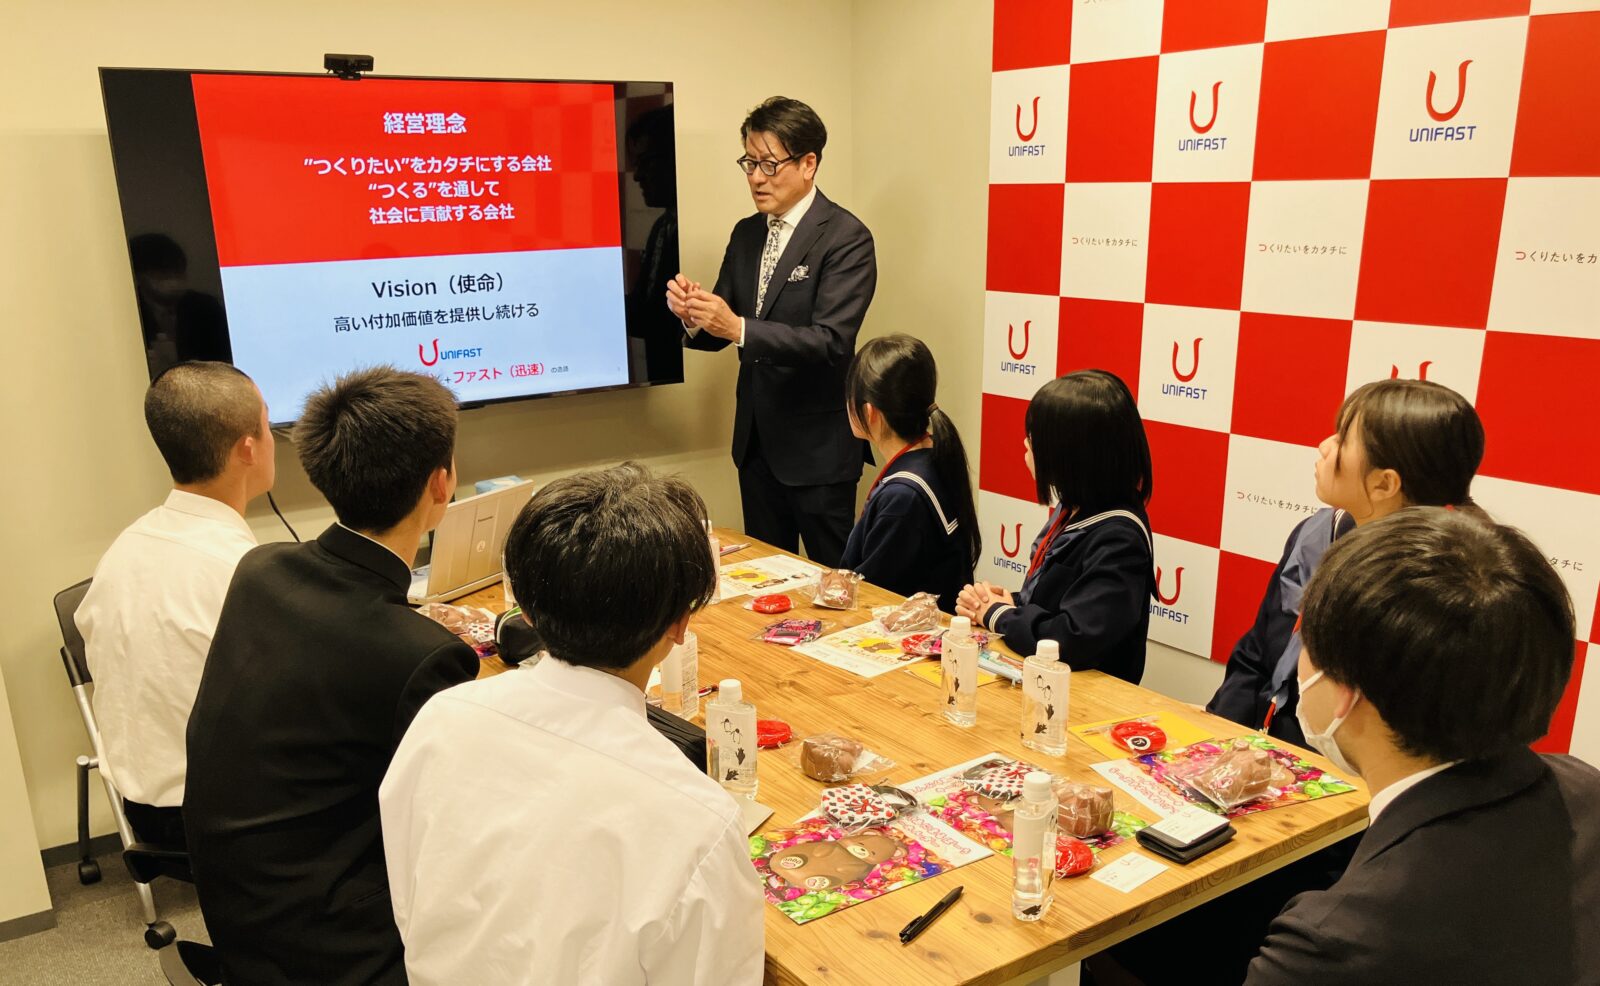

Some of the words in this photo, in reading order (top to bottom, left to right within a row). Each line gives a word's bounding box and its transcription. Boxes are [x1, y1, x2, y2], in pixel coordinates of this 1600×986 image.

[383, 112, 467, 135] 経営理念
[1409, 125, 1477, 143] UNIFAST
[1008, 144, 1046, 157] UNIFAST
[1178, 137, 1227, 152] UNIFAST
[369, 203, 515, 225] 社会に貢献する会社
[1071, 237, 1138, 248] つくりたいをカタチに
[1258, 243, 1348, 255] つくりたいをカタチに
[334, 303, 540, 333] 高い付加価値を提供し続ける
[440, 347, 483, 361] UNIFAST
[1000, 361, 1037, 376] UNIFAST
[1161, 383, 1208, 401] UNIFAST
[993, 556, 1028, 574] UNIFAST
